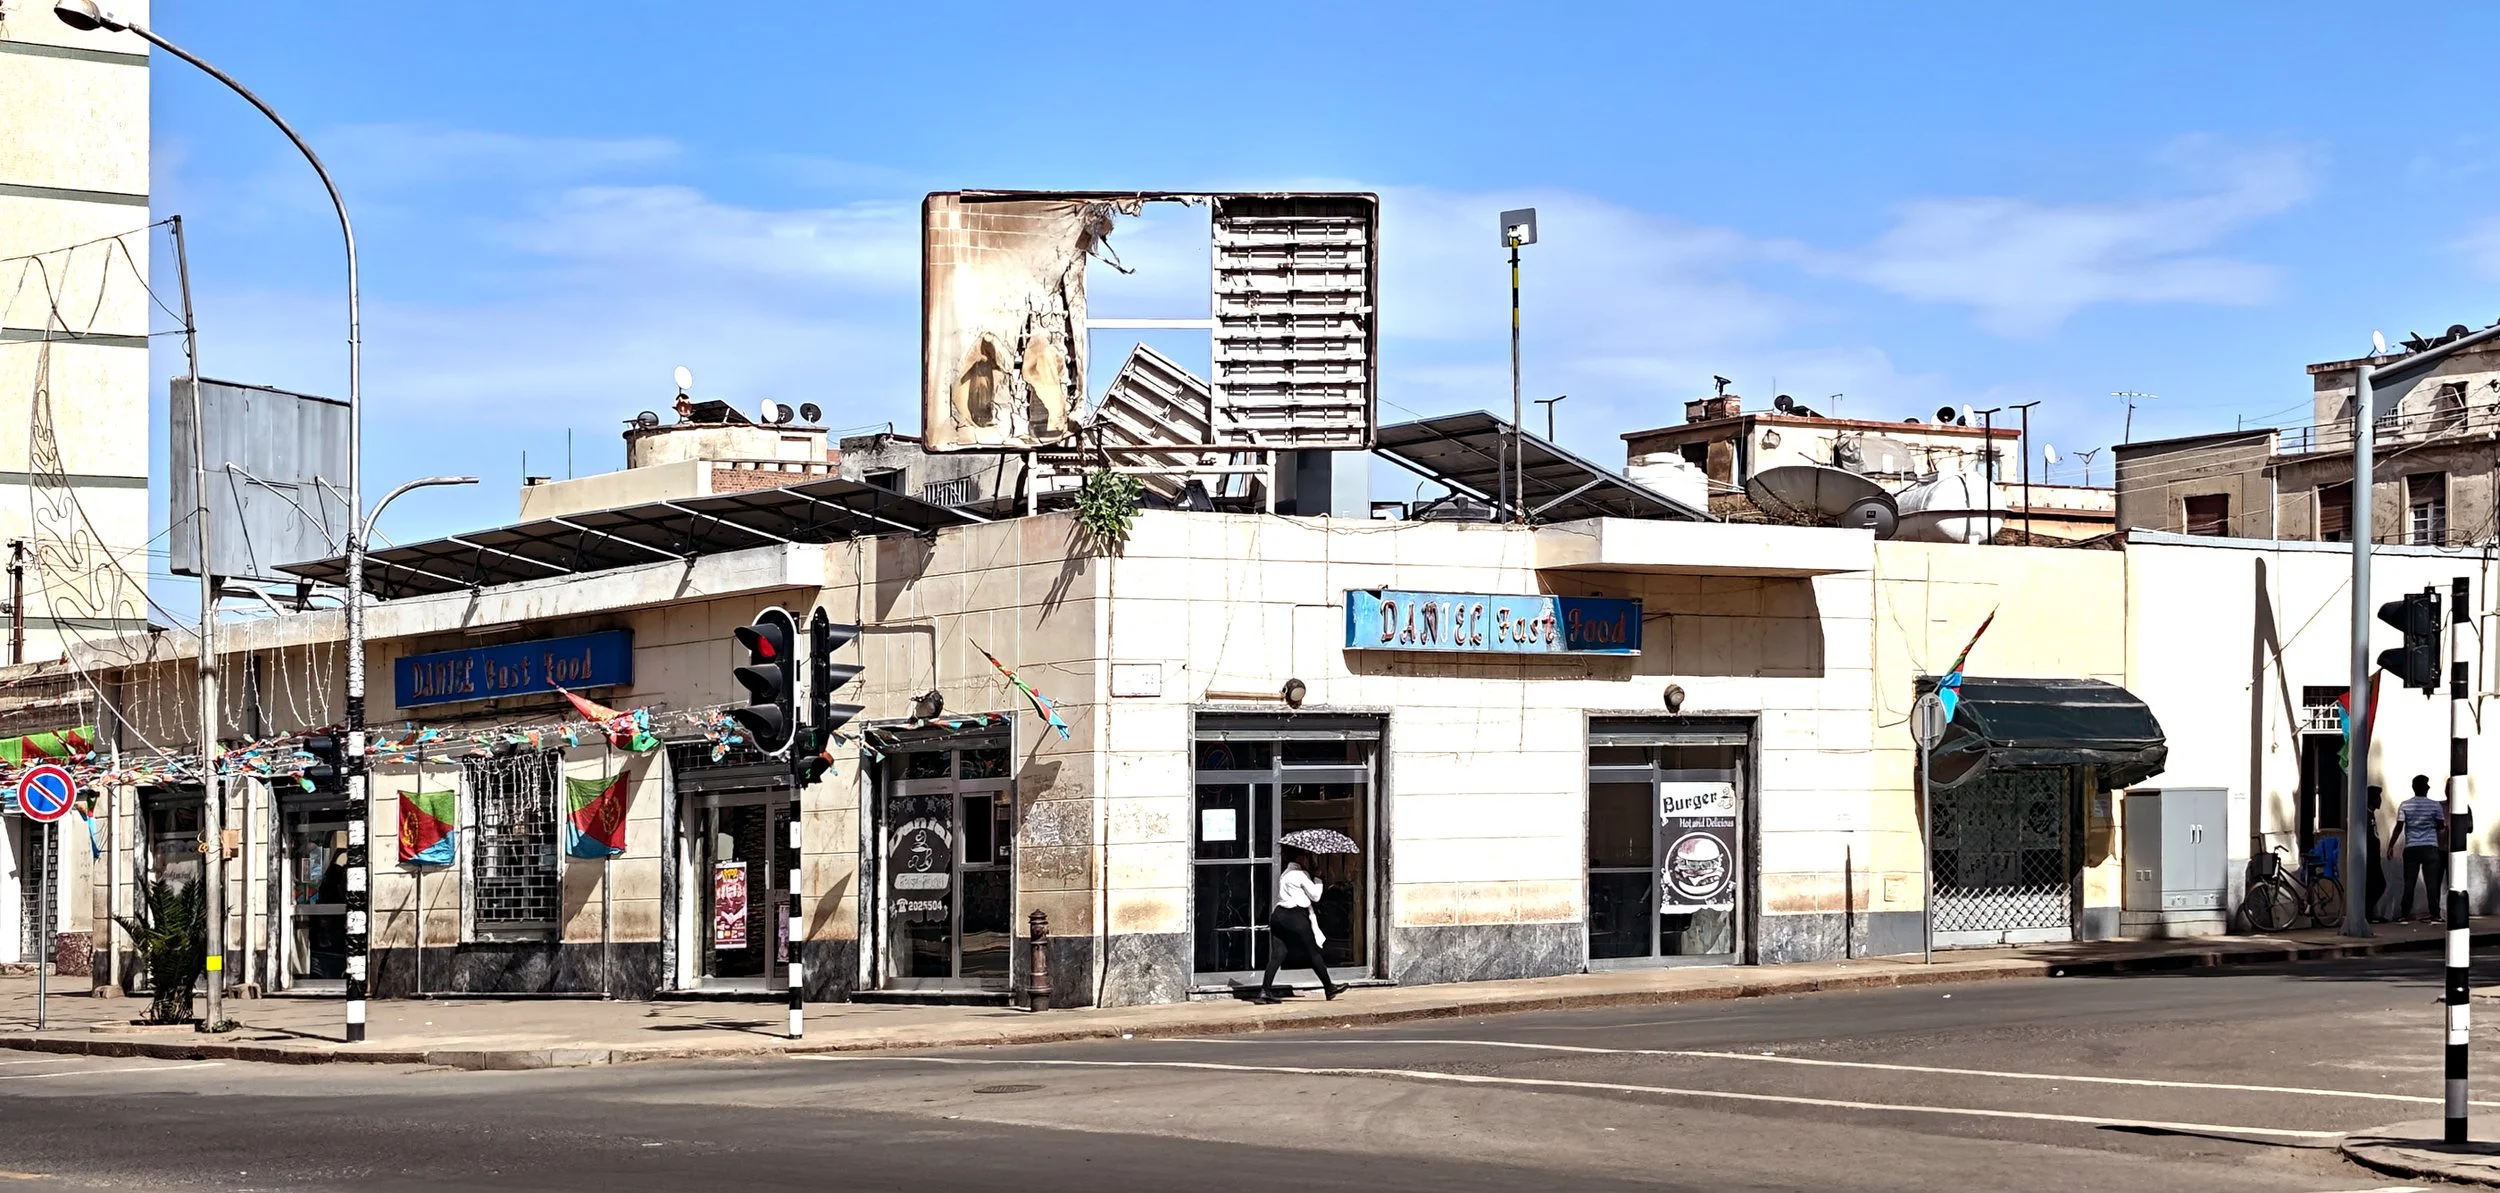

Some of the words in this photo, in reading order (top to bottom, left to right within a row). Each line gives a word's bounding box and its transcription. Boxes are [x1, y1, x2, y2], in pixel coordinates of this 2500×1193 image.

[1379, 599, 1485, 646] DANIEL
[1496, 605, 1556, 645] Fast
[1568, 608, 1627, 643] Food
[411, 656, 475, 698] DANIEL
[485, 657, 531, 690] Fast
[544, 647, 593, 684] Food
[1662, 792, 1718, 814] Burger
[1706, 817, 1734, 828] Delicious
